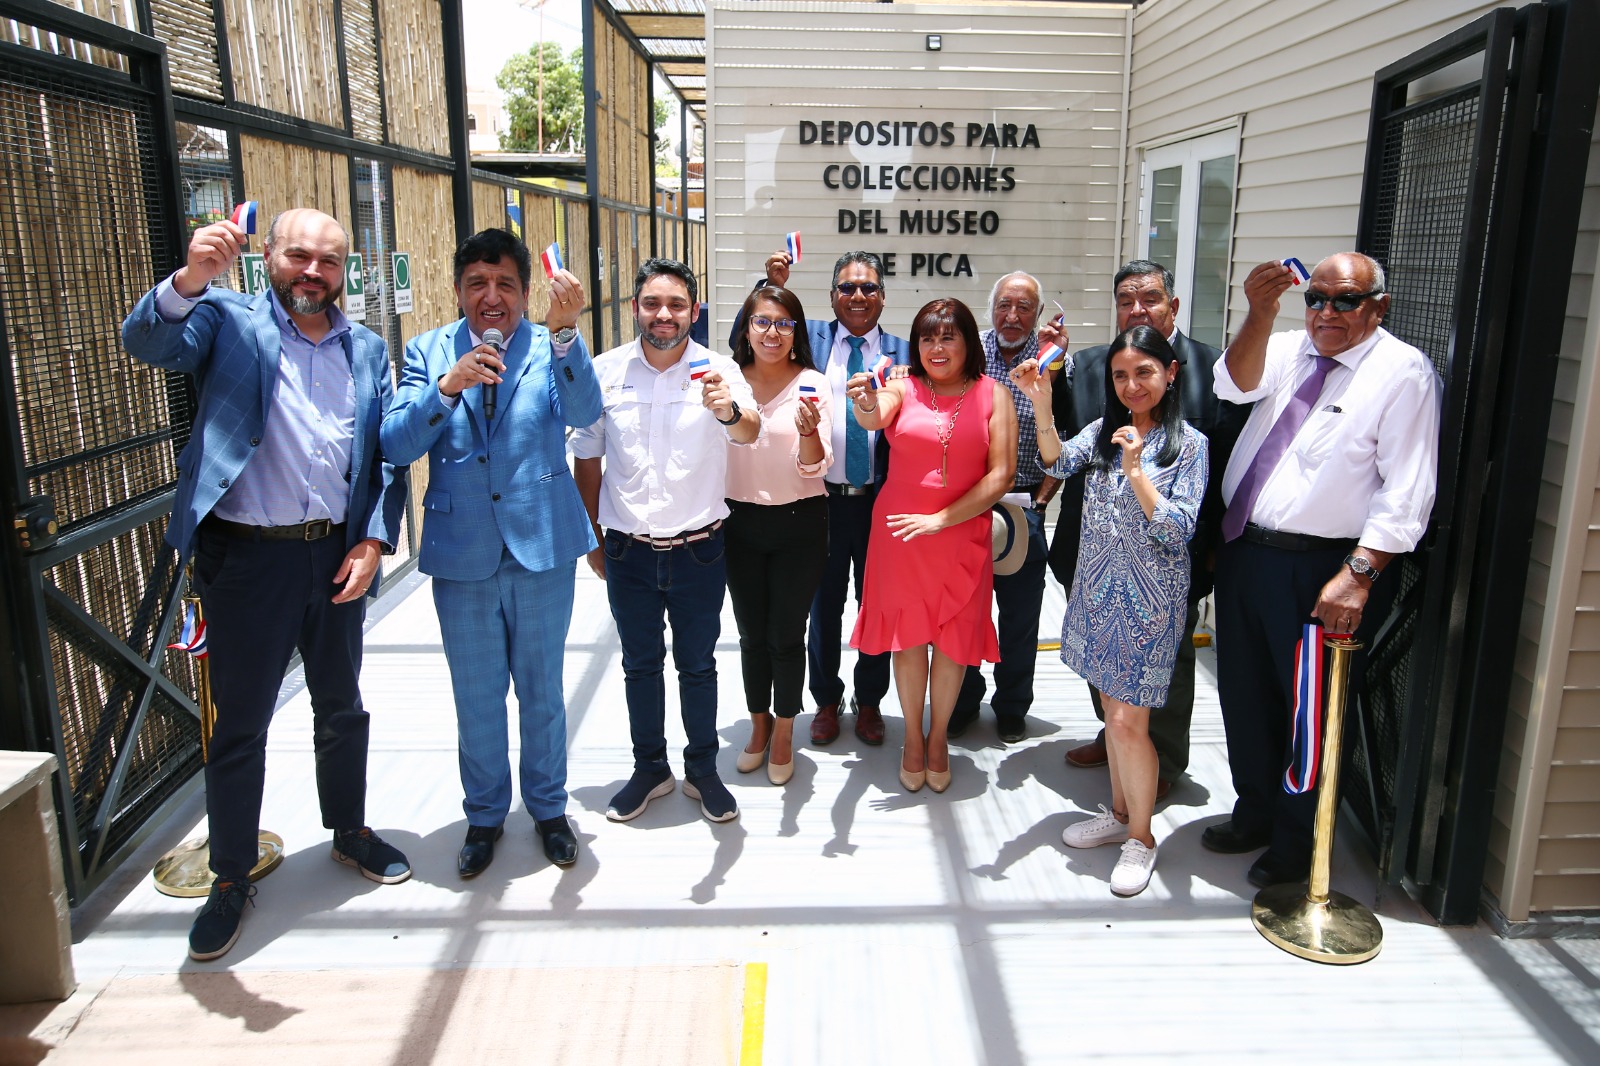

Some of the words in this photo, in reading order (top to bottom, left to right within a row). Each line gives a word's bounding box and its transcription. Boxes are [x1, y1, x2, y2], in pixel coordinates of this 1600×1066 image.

[799, 120, 955, 147] DEPOSITOS
[966, 122, 1041, 148] PARA
[823, 164, 1016, 192] COLECCIONES
[838, 209, 888, 234] DEL
[900, 209, 1000, 235] MUSEO
[869, 252, 896, 276] E
[910, 252, 973, 277] PICA
